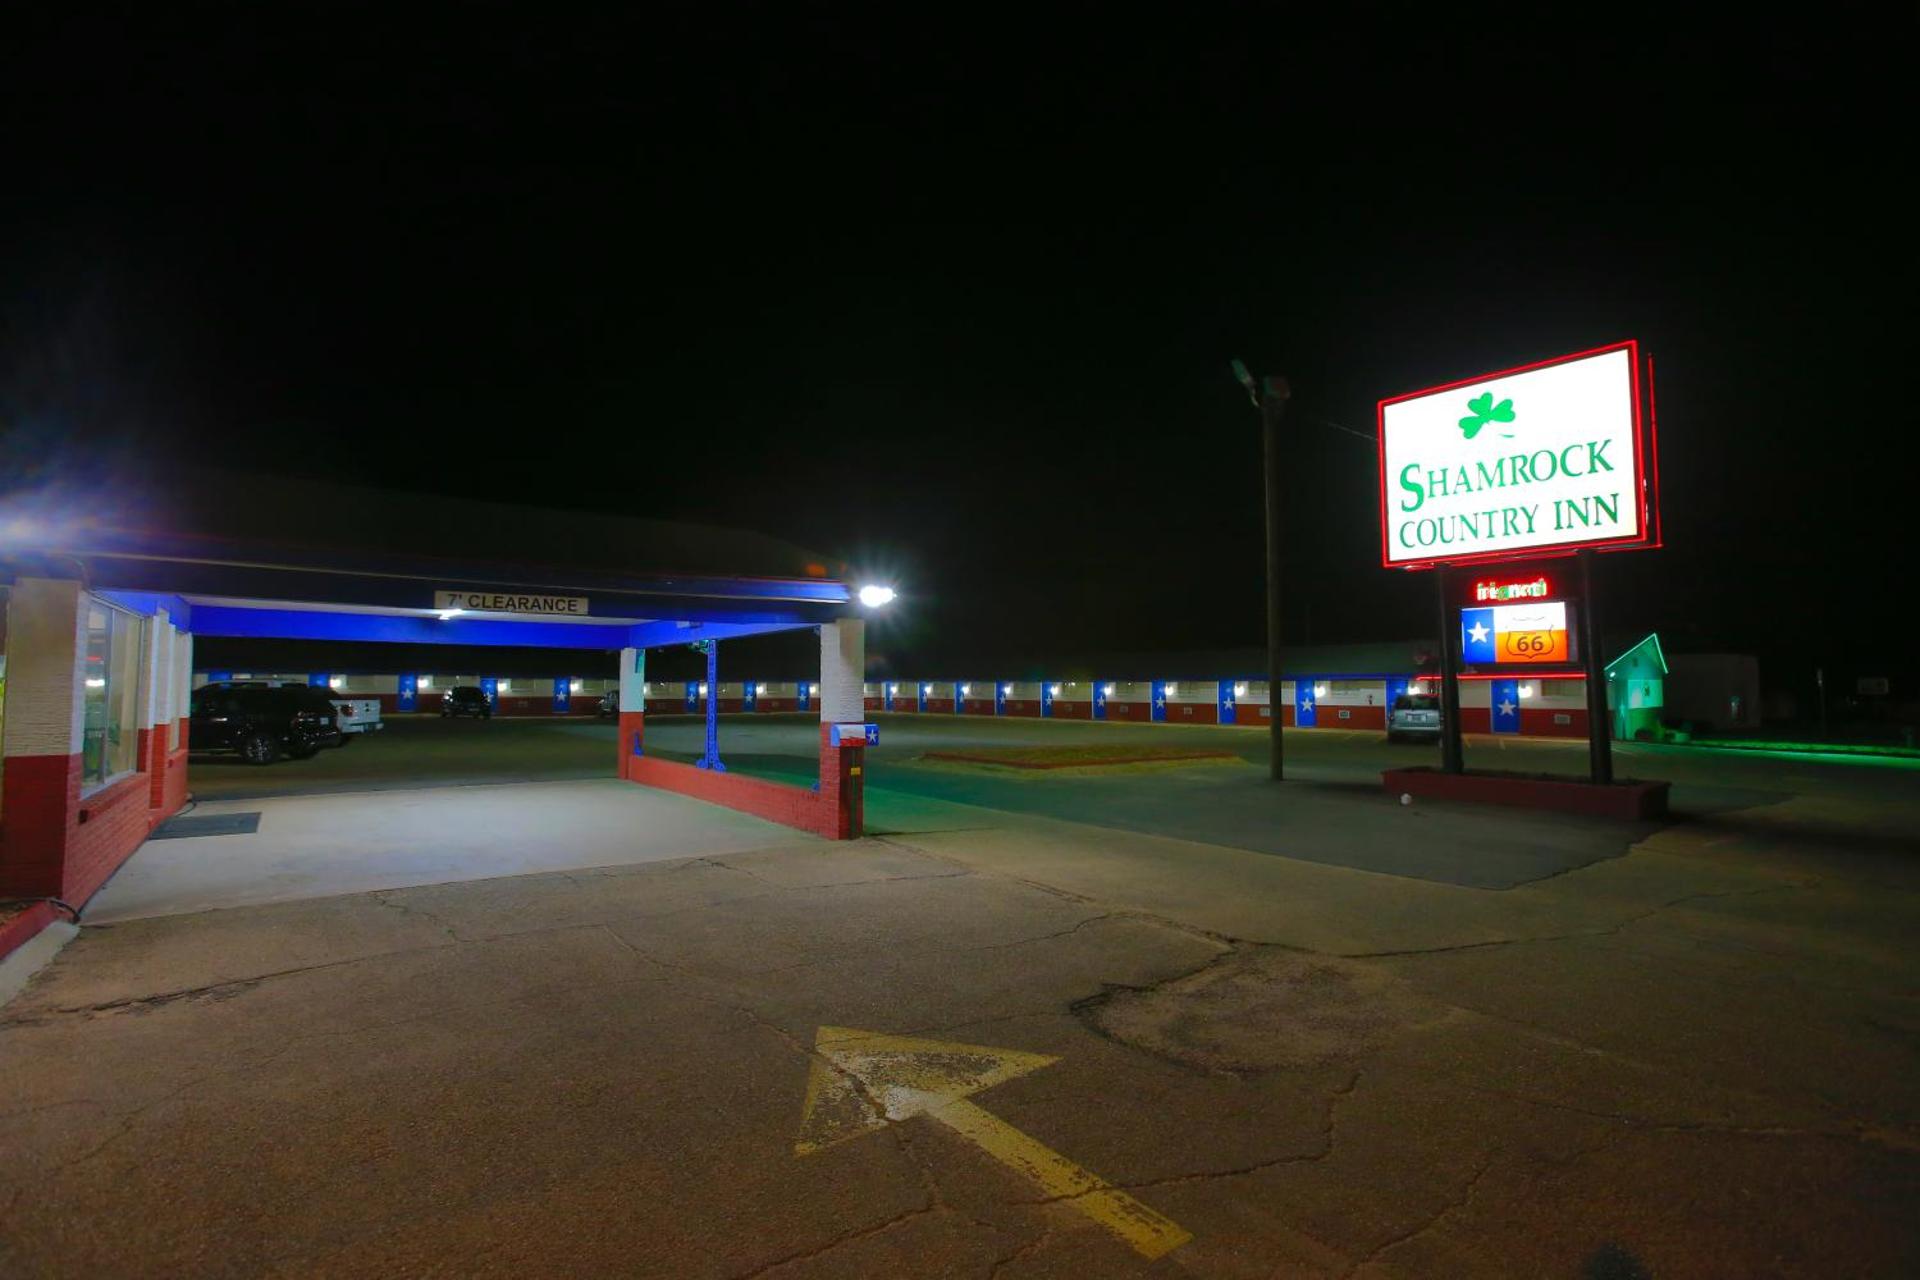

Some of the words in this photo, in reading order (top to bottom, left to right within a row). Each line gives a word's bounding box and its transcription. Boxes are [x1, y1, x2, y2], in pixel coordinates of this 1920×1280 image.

[1399, 439, 1614, 512] SHAMROCK
[1399, 504, 1539, 548] COUNTRY
[1554, 493, 1620, 531] INN
[468, 594, 578, 612] CLEARANCE
[1516, 636, 1544, 652] 66
